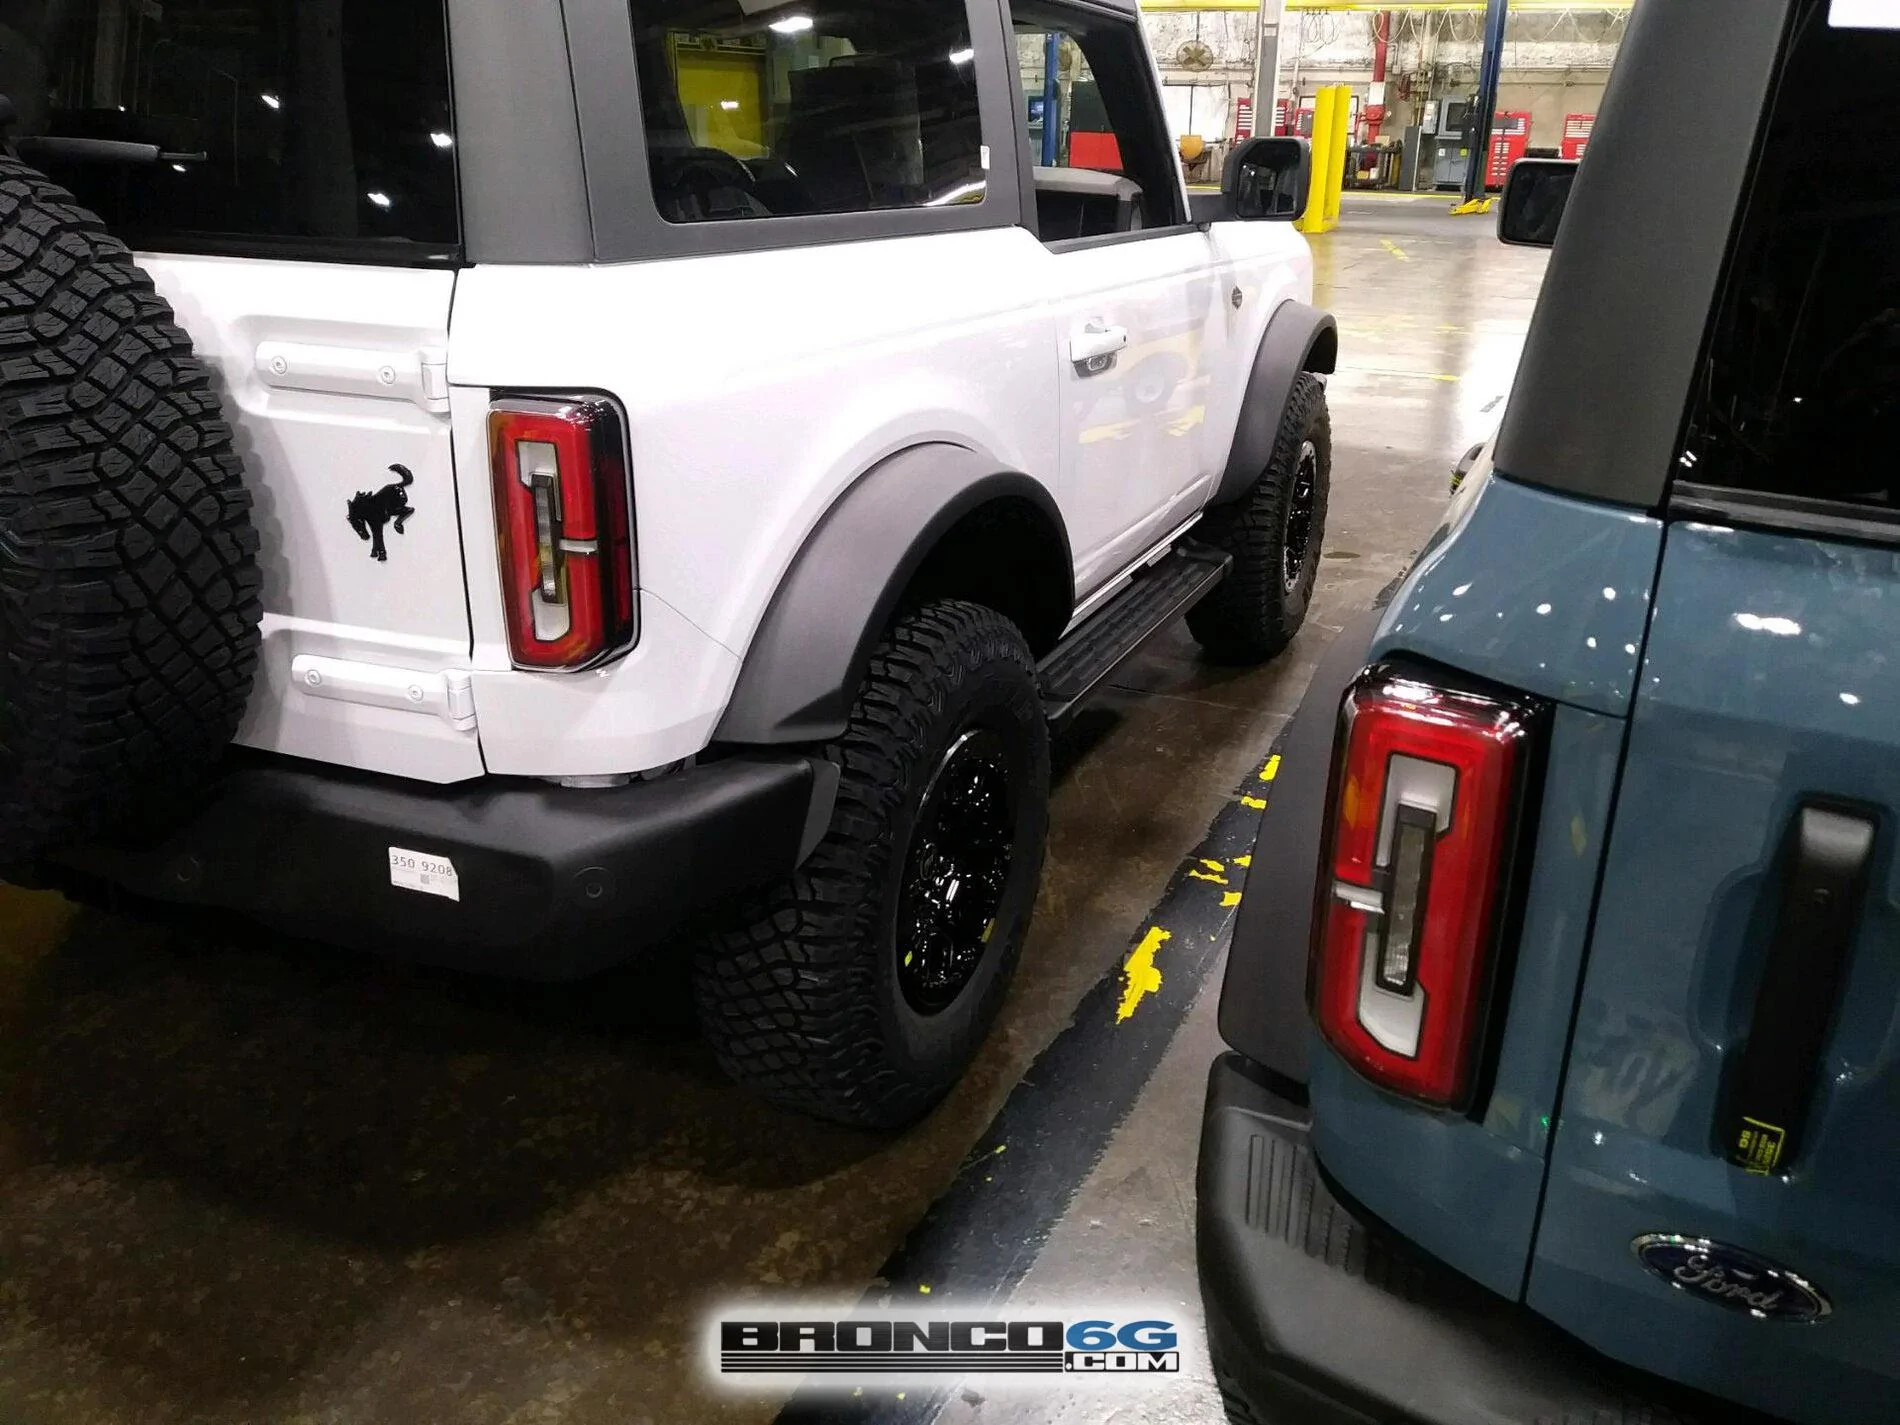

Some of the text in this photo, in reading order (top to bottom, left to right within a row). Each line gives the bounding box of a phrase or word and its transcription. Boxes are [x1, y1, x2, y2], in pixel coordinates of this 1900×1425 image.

[391, 854, 415, 869] 350
[421, 861, 453, 877] 9208
[1673, 1255, 1783, 1310] Ford
